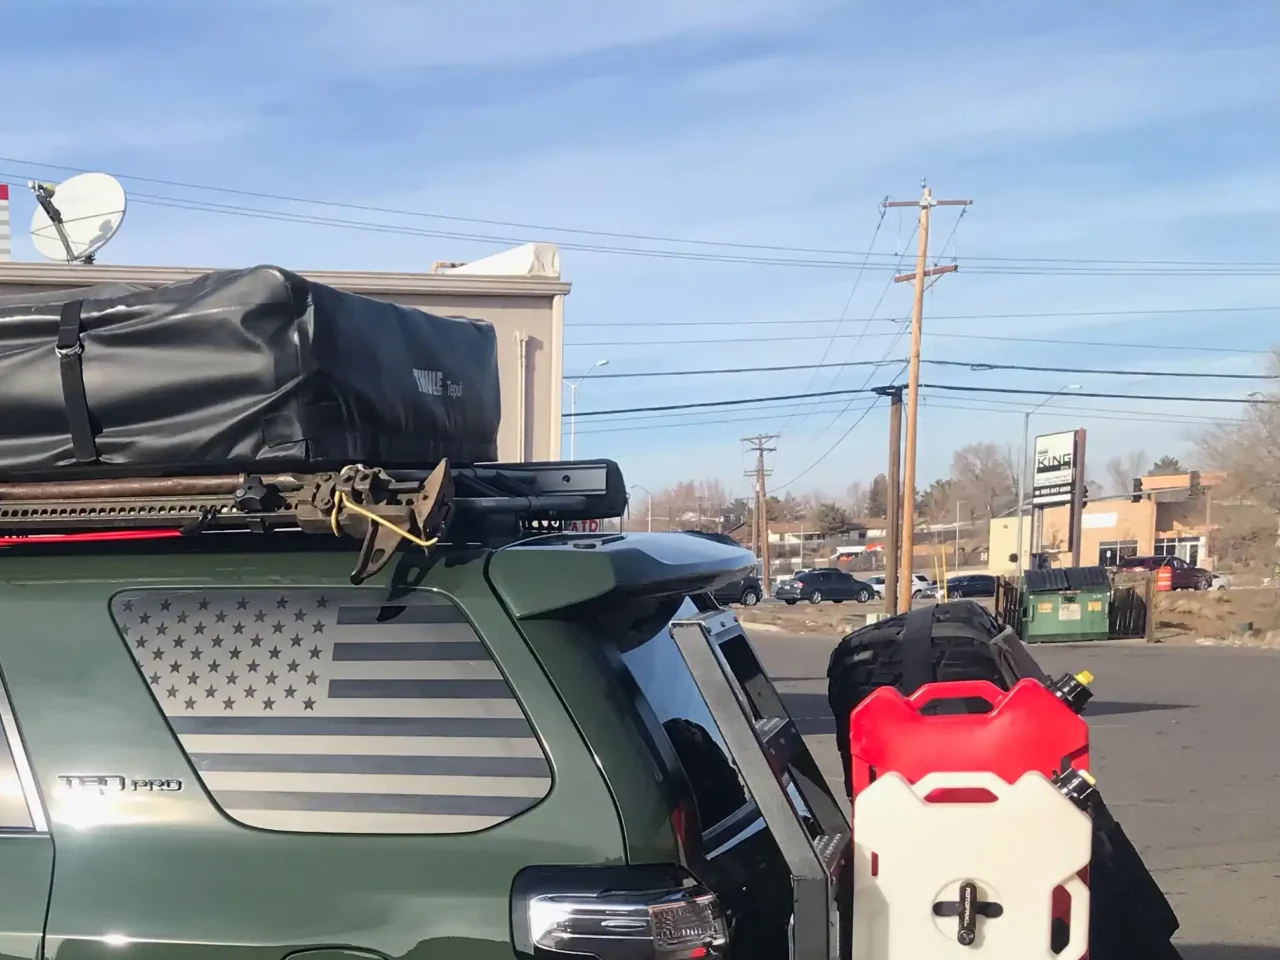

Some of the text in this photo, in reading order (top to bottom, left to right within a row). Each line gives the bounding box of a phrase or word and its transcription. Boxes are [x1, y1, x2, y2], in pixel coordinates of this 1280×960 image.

[412, 368, 463, 400] THULE Tepui
[1038, 453, 1071, 469] KING
[130, 778, 183, 791] PRO
